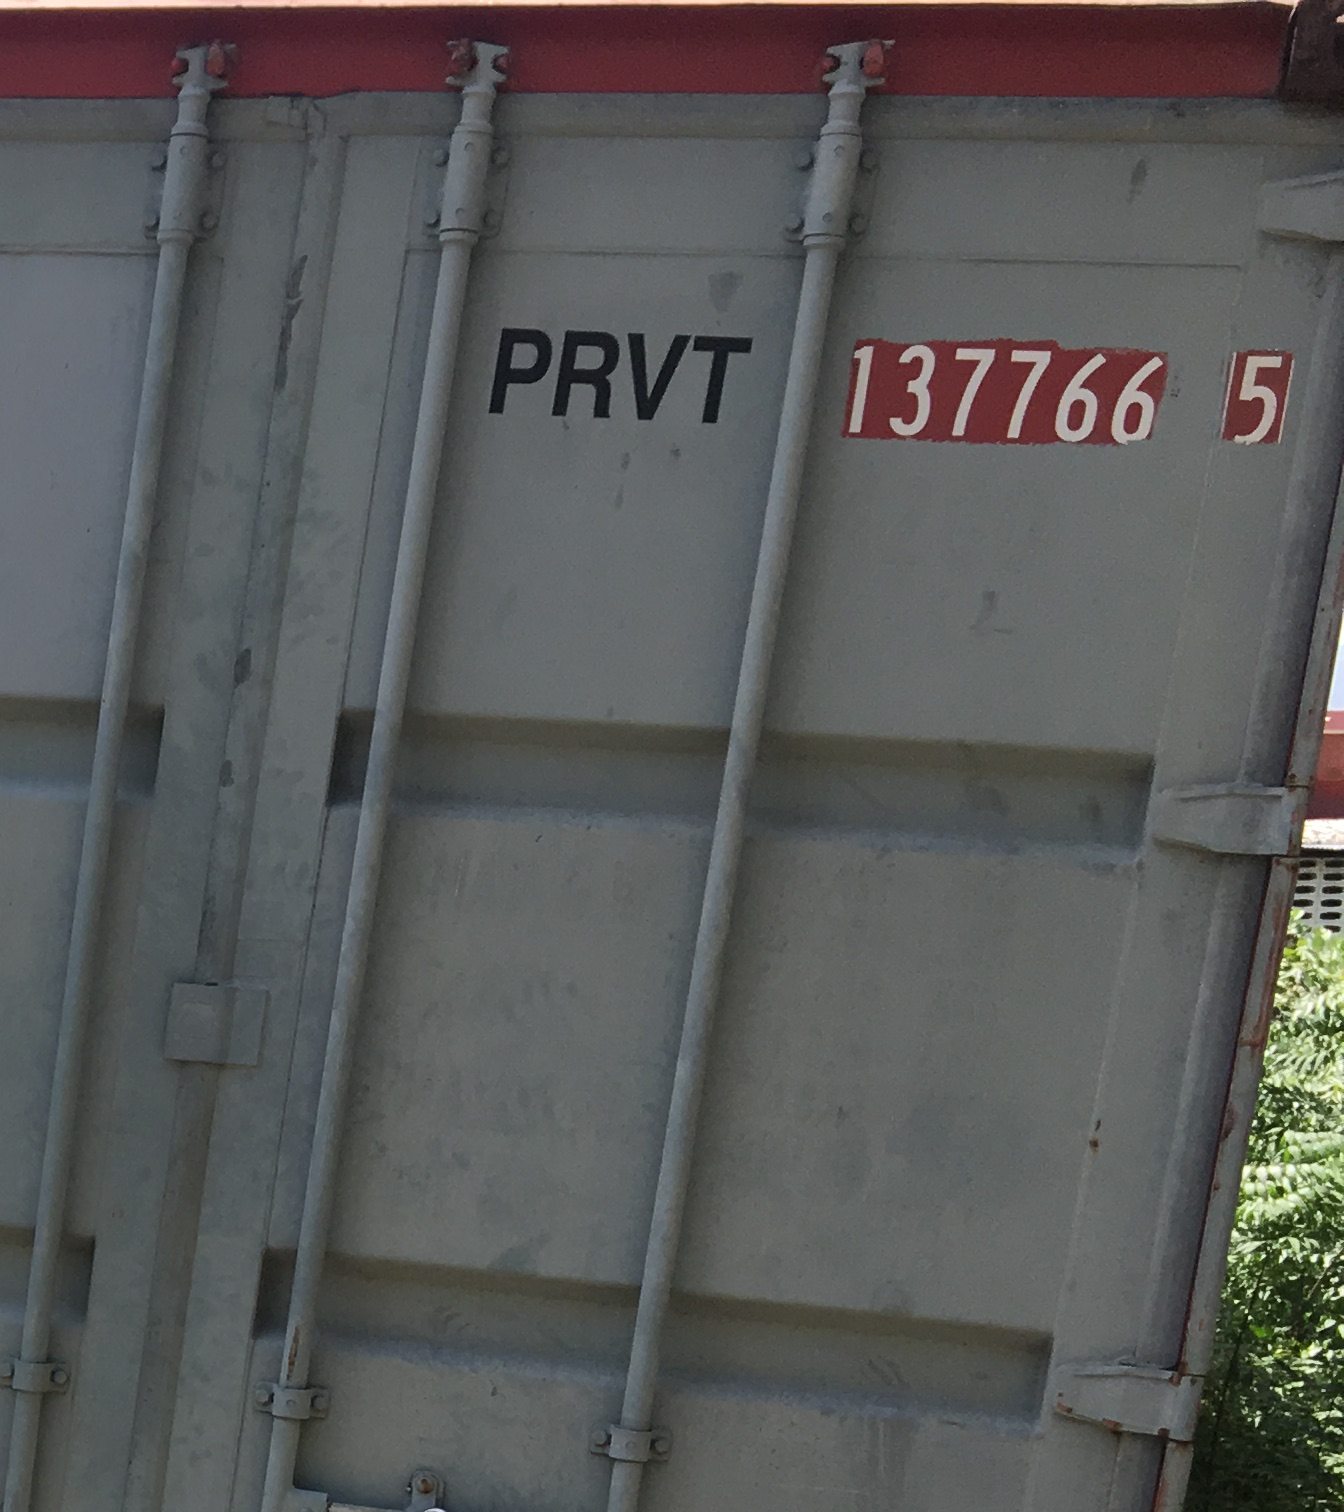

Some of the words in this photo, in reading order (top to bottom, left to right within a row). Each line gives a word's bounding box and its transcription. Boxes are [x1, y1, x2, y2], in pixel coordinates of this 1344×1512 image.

[488, 328, 752, 424] PRVT
[848, 345, 1167, 444] 137766
[1233, 354, 1283, 446] 5
